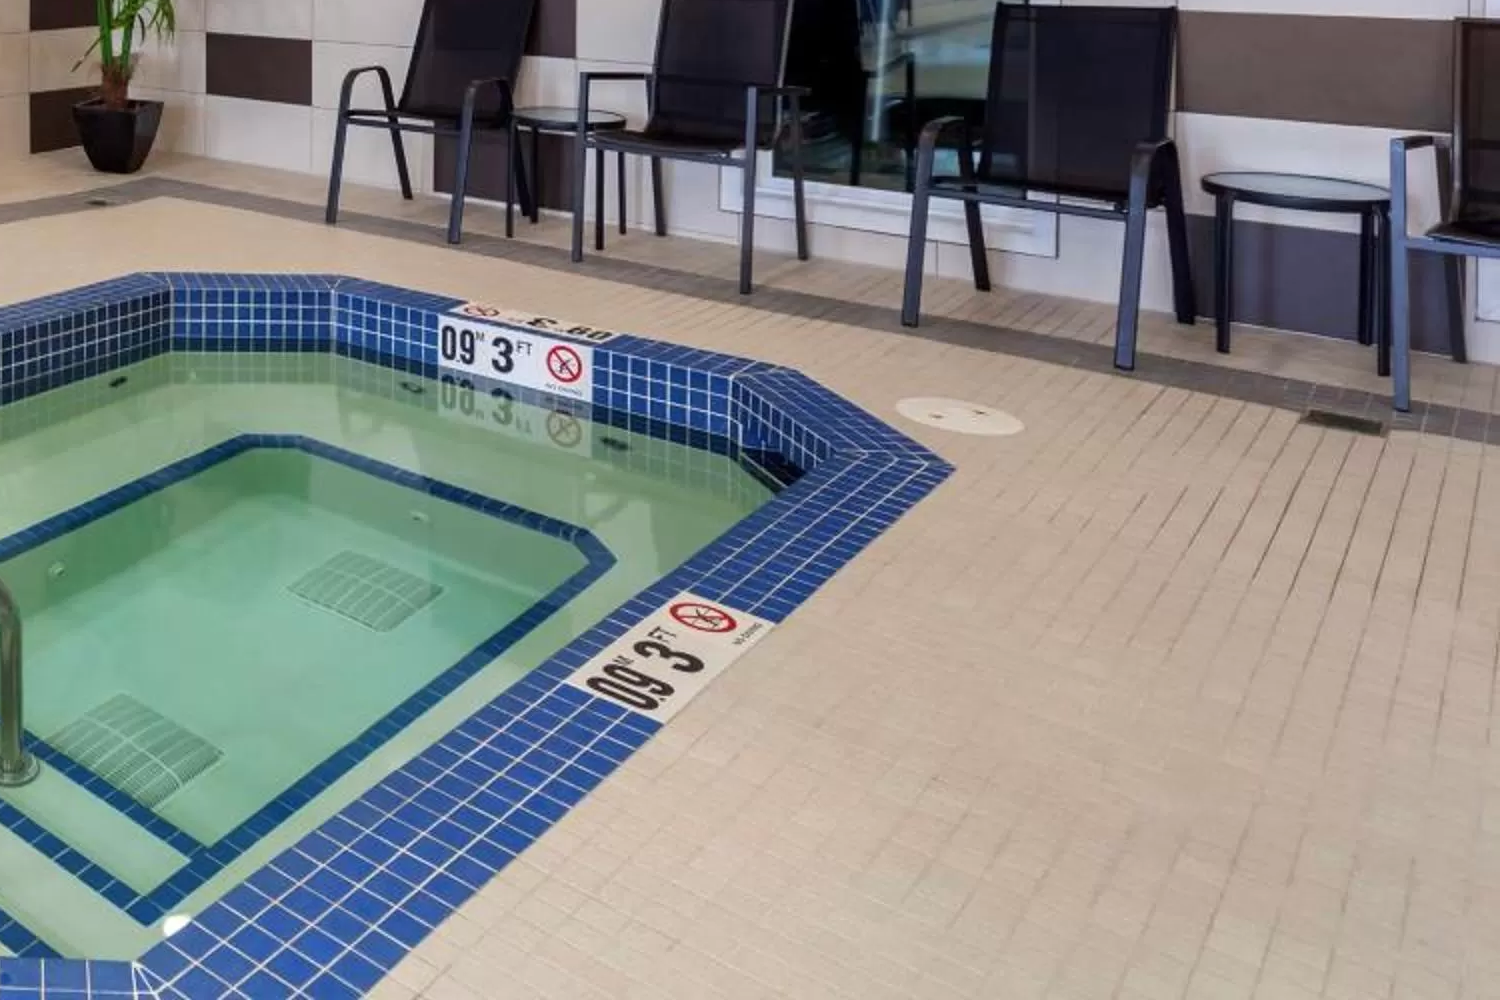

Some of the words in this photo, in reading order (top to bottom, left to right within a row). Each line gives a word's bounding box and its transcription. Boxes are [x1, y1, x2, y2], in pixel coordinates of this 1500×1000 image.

[492, 337, 514, 373] 3
[516, 341, 533, 356] FT
[647, 626, 677, 642] FT
[633, 640, 705, 673] 3
